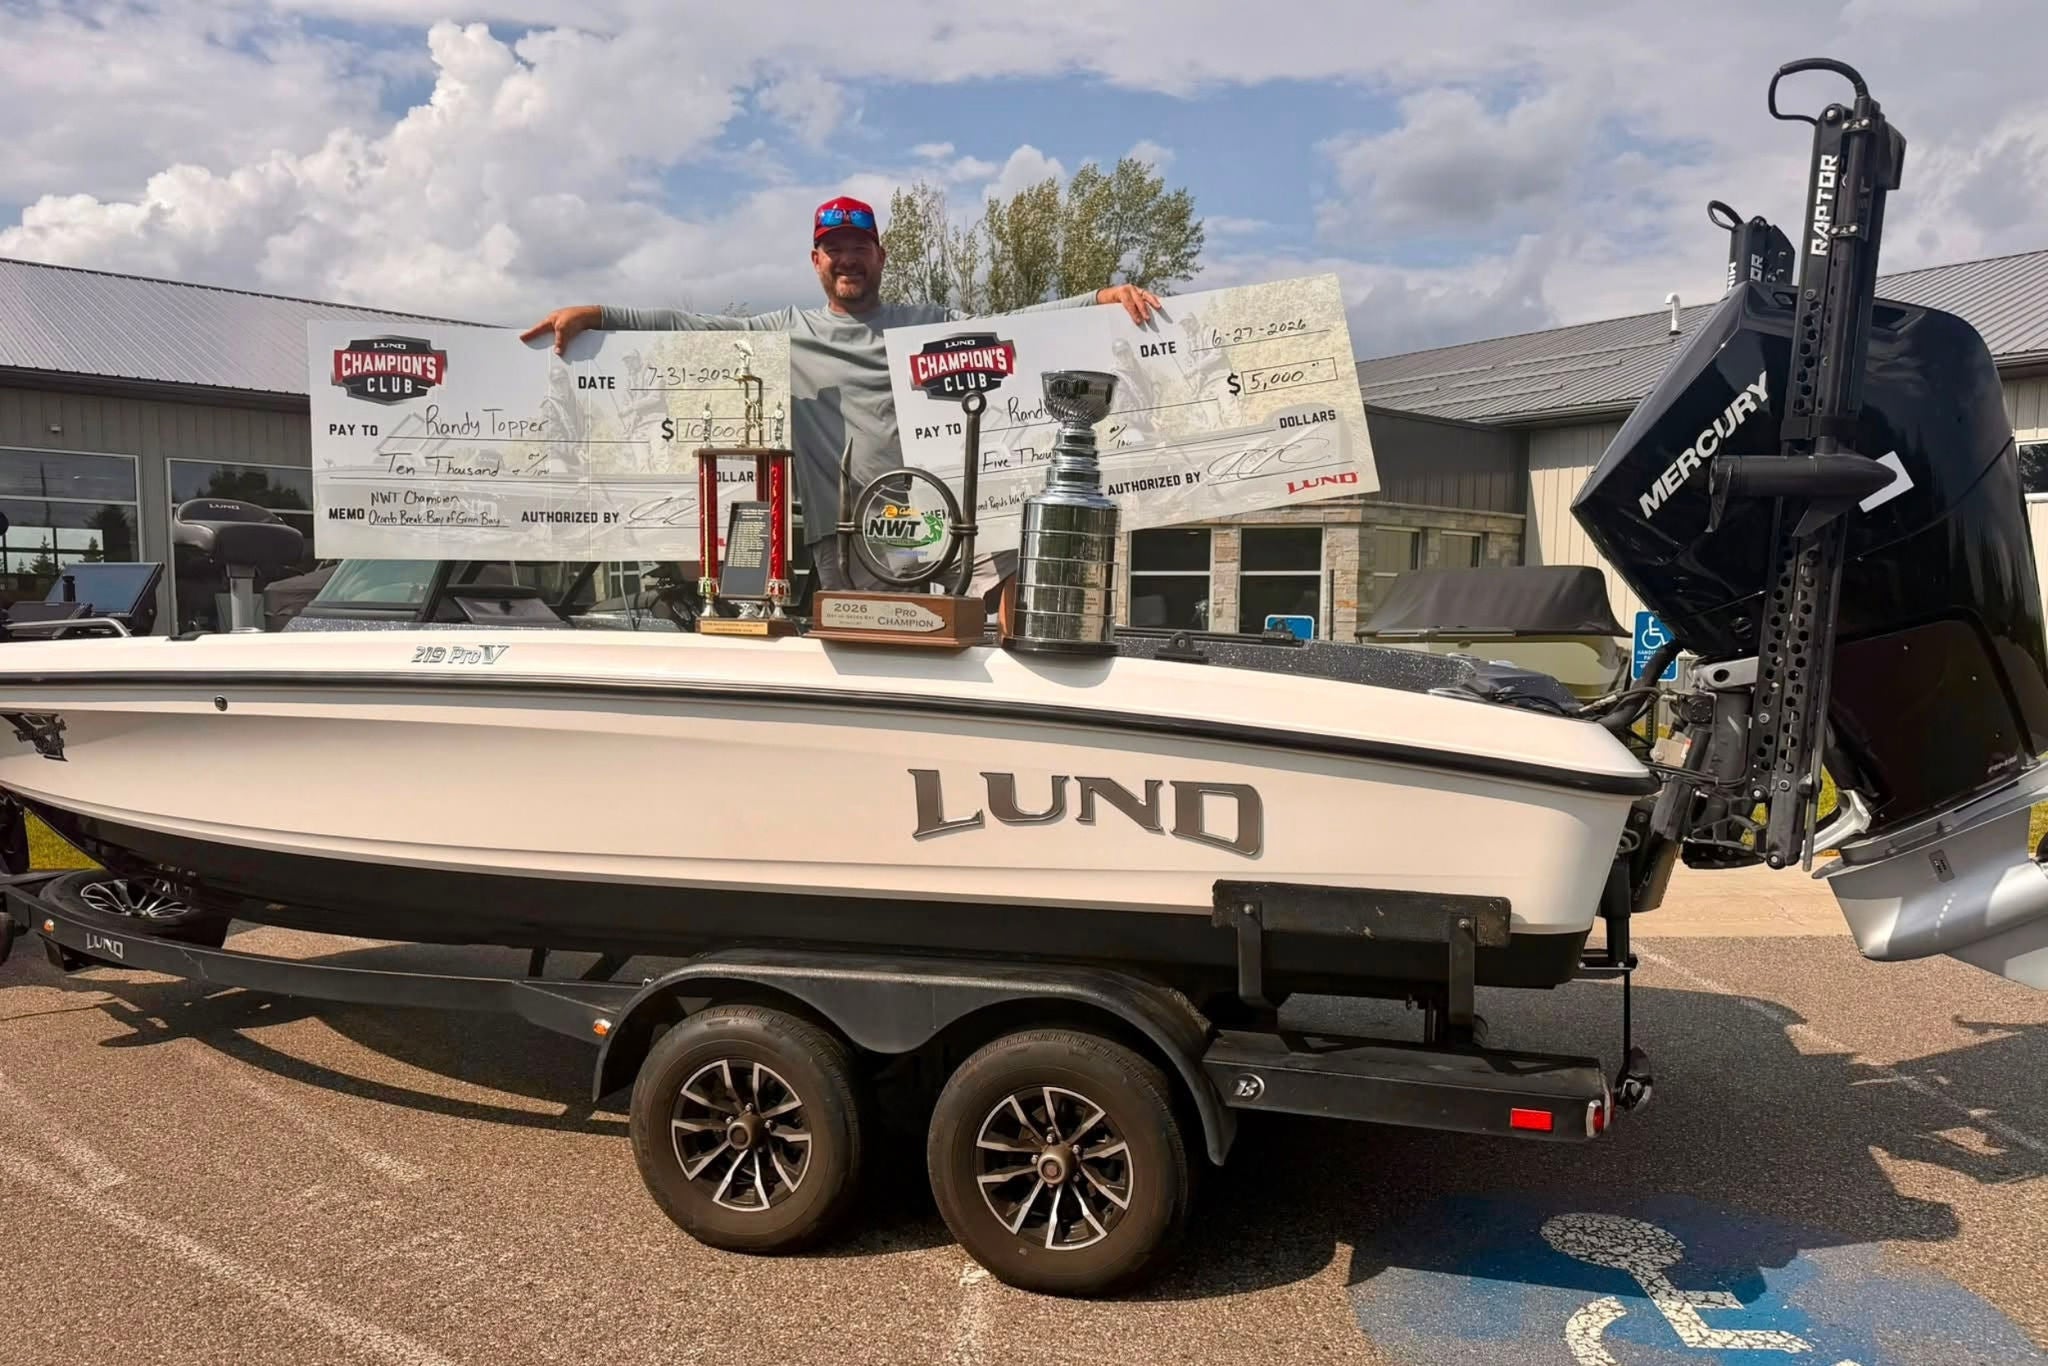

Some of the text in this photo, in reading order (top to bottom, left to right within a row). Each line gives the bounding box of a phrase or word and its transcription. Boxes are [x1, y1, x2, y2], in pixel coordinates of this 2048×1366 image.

[1810, 154, 1839, 256] RAPTOR
[1212, 317, 1307, 345] 6-27-2026
[373, 342, 407, 350] LUND
[945, 339, 976, 349] LUND
[1140, 341, 1177, 358] DATE
[341, 352, 436, 380] CHAMPION'S
[917, 348, 1008, 380] CHAMPION'S
[367, 375, 412, 394] CLUB
[578, 376, 615, 390] DATE
[944, 373, 987, 392] CLUB
[1227, 373, 1242, 396] $
[425, 404, 549, 438] Randy Topper
[1279, 410, 1336, 429] DOLLARS
[329, 424, 378, 437] PAY TO
[661, 418, 674, 442] $
[915, 423, 961, 440] PAY TO
[1638, 371, 1770, 520] MERCURY
[378, 452, 415, 476] Ten
[425, 456, 500, 477] Thousand
[983, 450, 1011, 472] Five
[716, 471, 754, 482] OLLAR
[1107, 472, 1201, 496] AUTHORIZED BY
[1287, 472, 1359, 494] LUND
[371, 491, 400, 506] NWT
[329, 508, 365, 520] MEMO
[521, 511, 619, 524] AUTHORIZED BY
[867, 519, 921, 538] NWT
[834, 603, 868, 613] 2026
[411, 646, 447, 663] 219
[907, 768, 1264, 860] LUND
[86, 932, 123, 960] LUND
